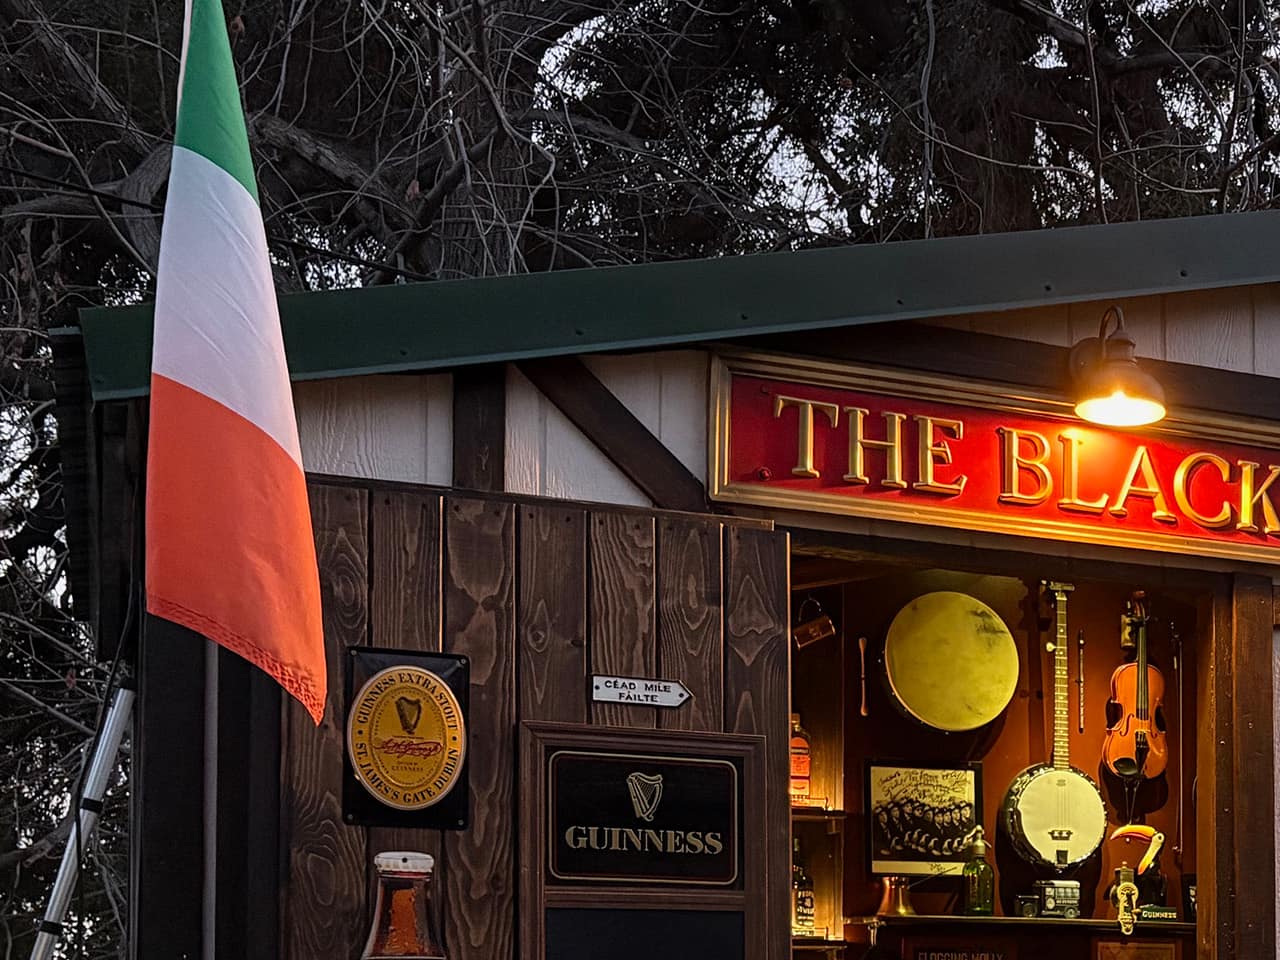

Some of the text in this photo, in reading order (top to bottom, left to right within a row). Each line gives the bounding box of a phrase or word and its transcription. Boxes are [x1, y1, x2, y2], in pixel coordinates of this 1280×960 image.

[773, 394, 967, 495] THE
[357, 673, 458, 731] GUINNESS EXTRA STOUT
[604, 679, 637, 690] CÉAD
[359, 762, 400, 800] JAMES'S
[403, 787, 436, 804] GATE
[434, 747, 459, 791] DUBLIN
[565, 825, 723, 855] GUINNESS
